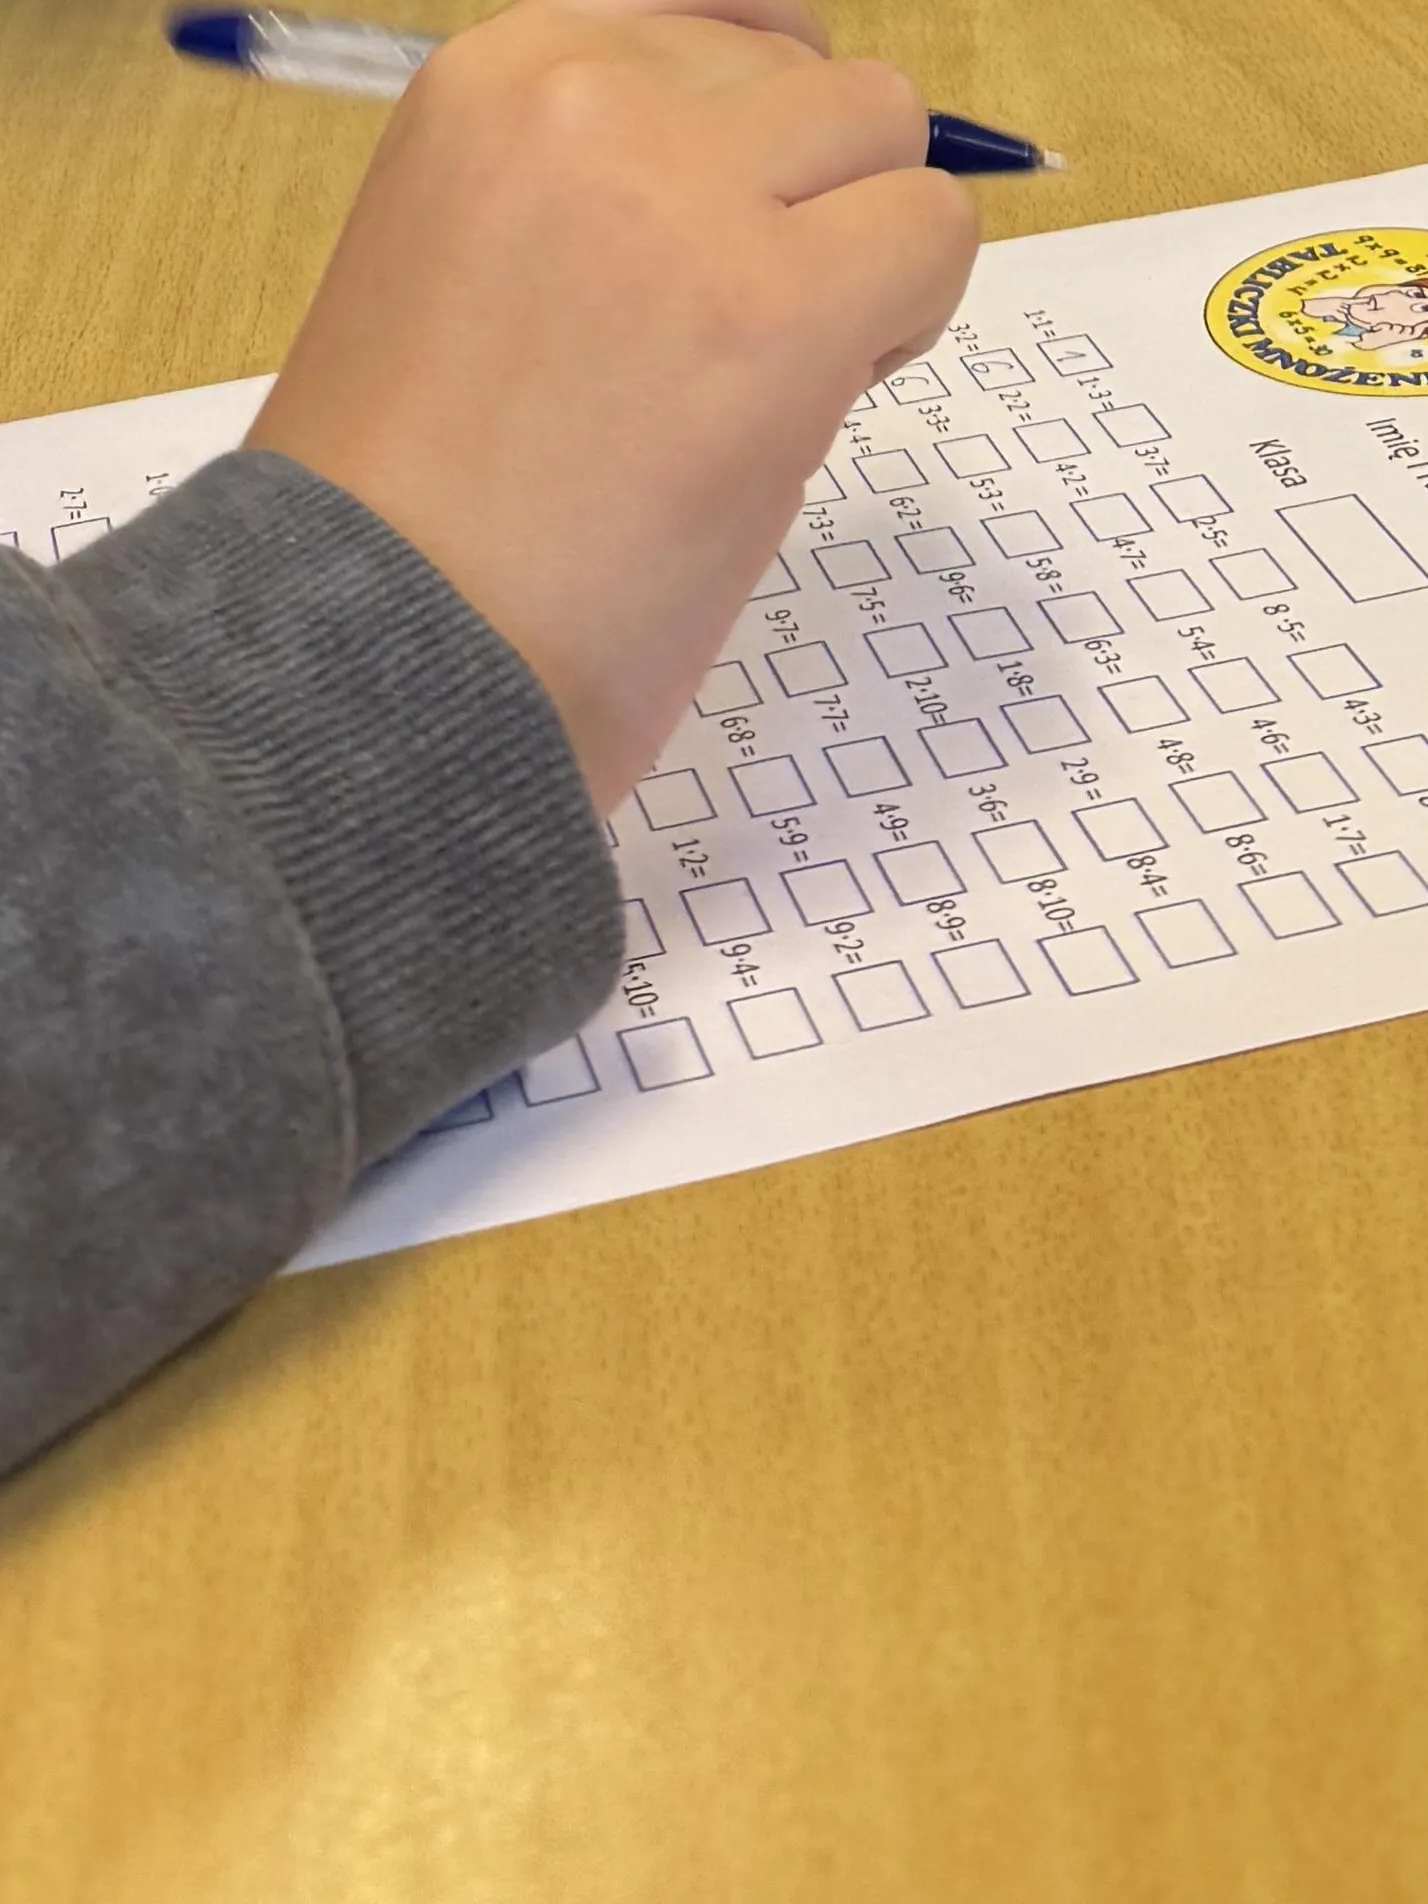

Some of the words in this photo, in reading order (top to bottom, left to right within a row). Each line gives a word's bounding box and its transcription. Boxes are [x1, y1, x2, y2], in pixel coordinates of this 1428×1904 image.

[1227, 242, 1348, 338] TABLICZKI
[971, 360, 1014, 374] 6
[1056, 350, 1087, 363] 1
[891, 376, 930, 387] 6
[1366, 418, 1419, 460] Imię
[1249, 439, 1307, 488] Klasa
